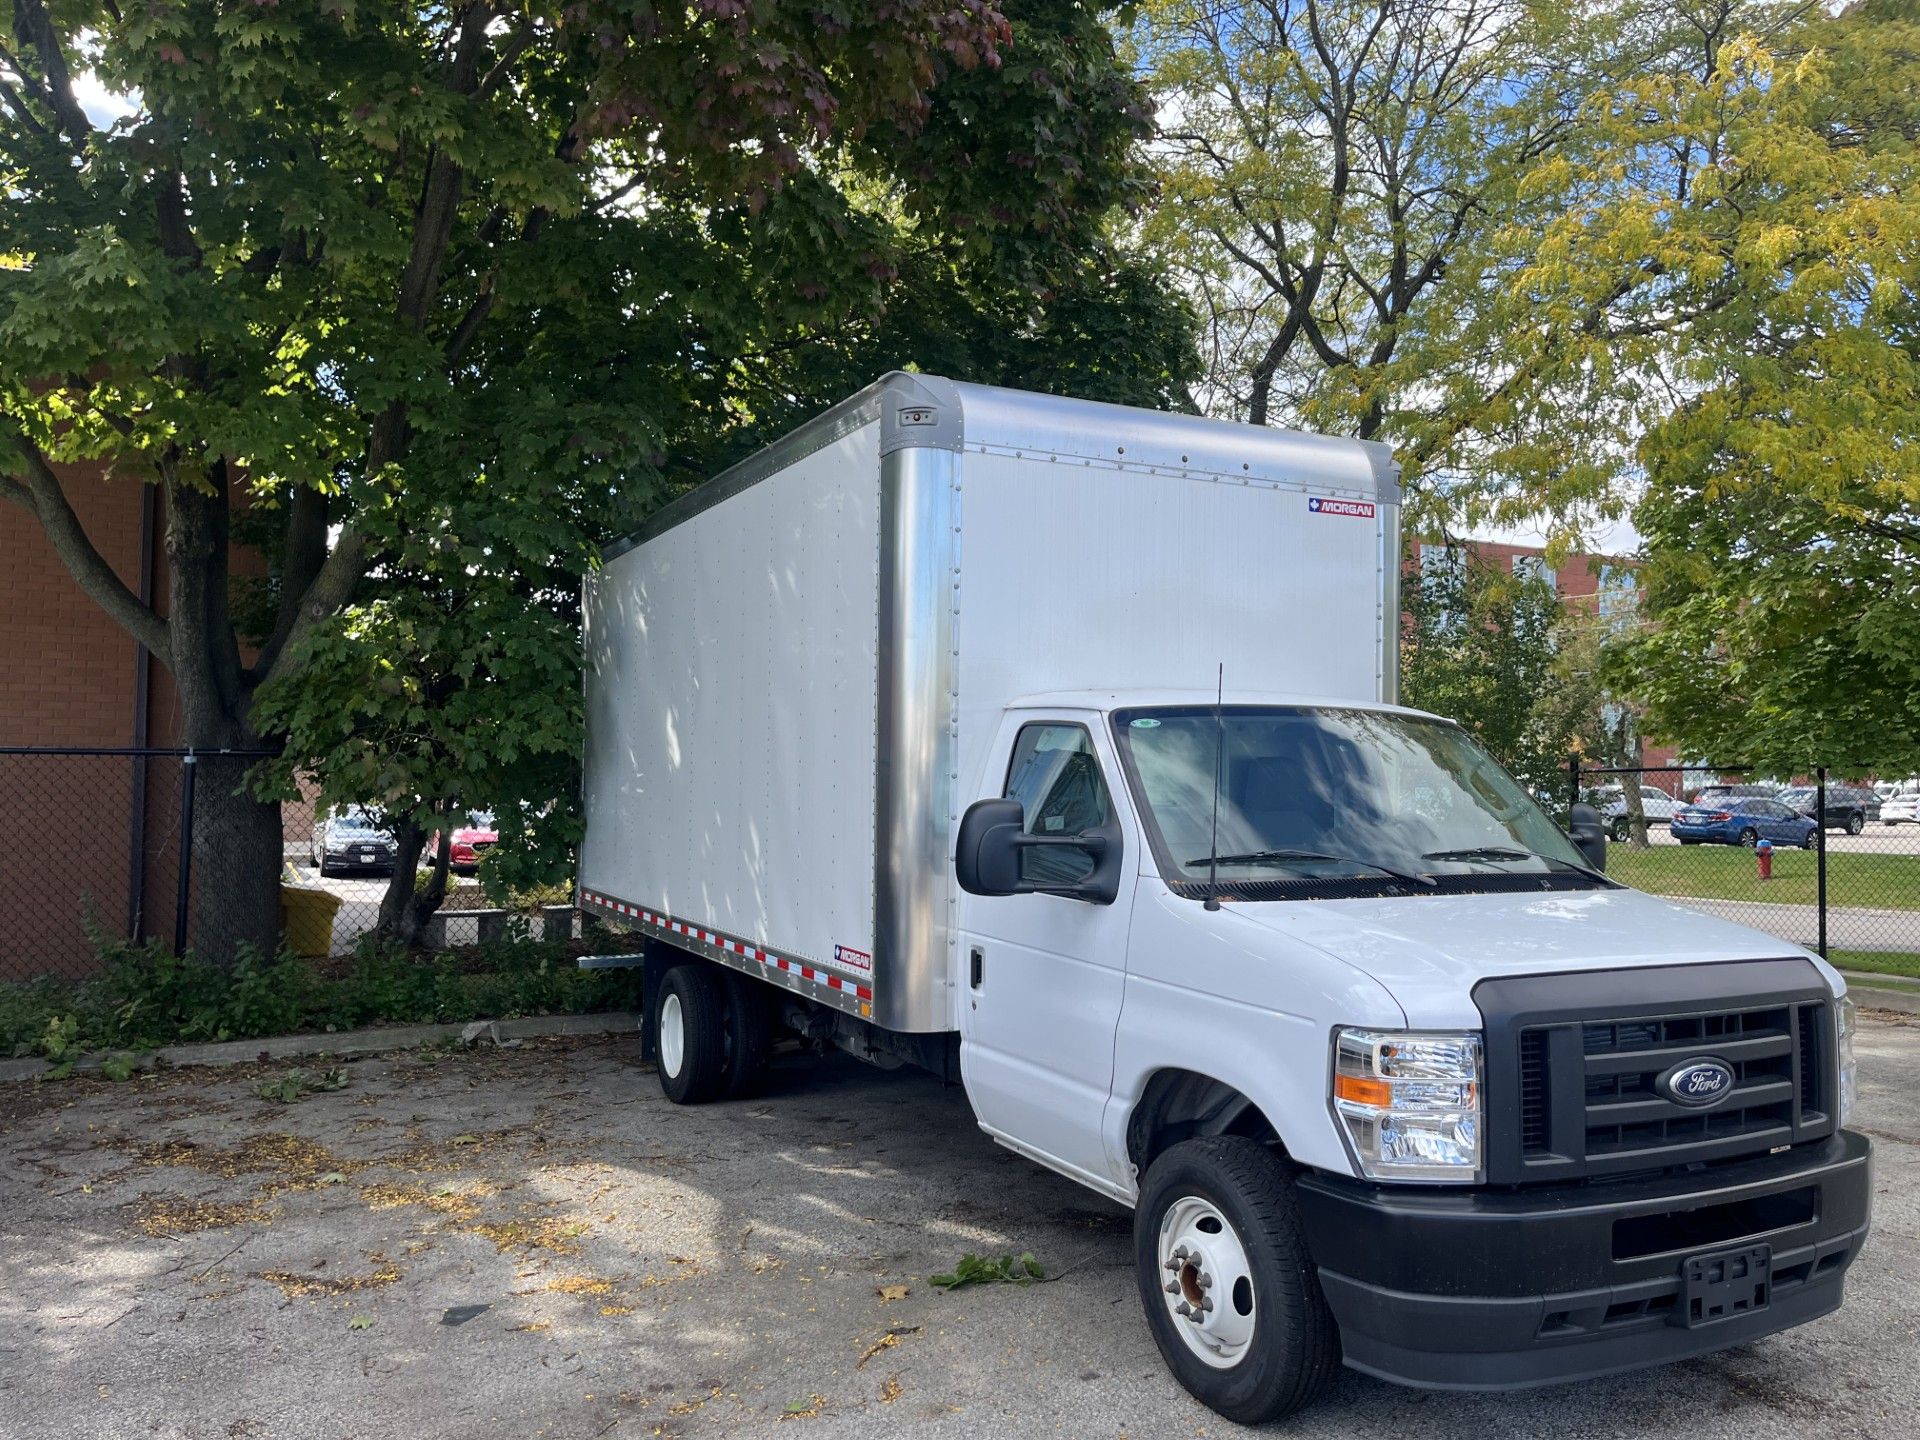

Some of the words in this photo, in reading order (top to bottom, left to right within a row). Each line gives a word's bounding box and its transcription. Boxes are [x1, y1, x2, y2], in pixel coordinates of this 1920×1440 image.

[1321, 501, 1372, 516] MORGAN
[840, 948, 870, 968] MORGAN
[1688, 1070, 1721, 1093] Ford
